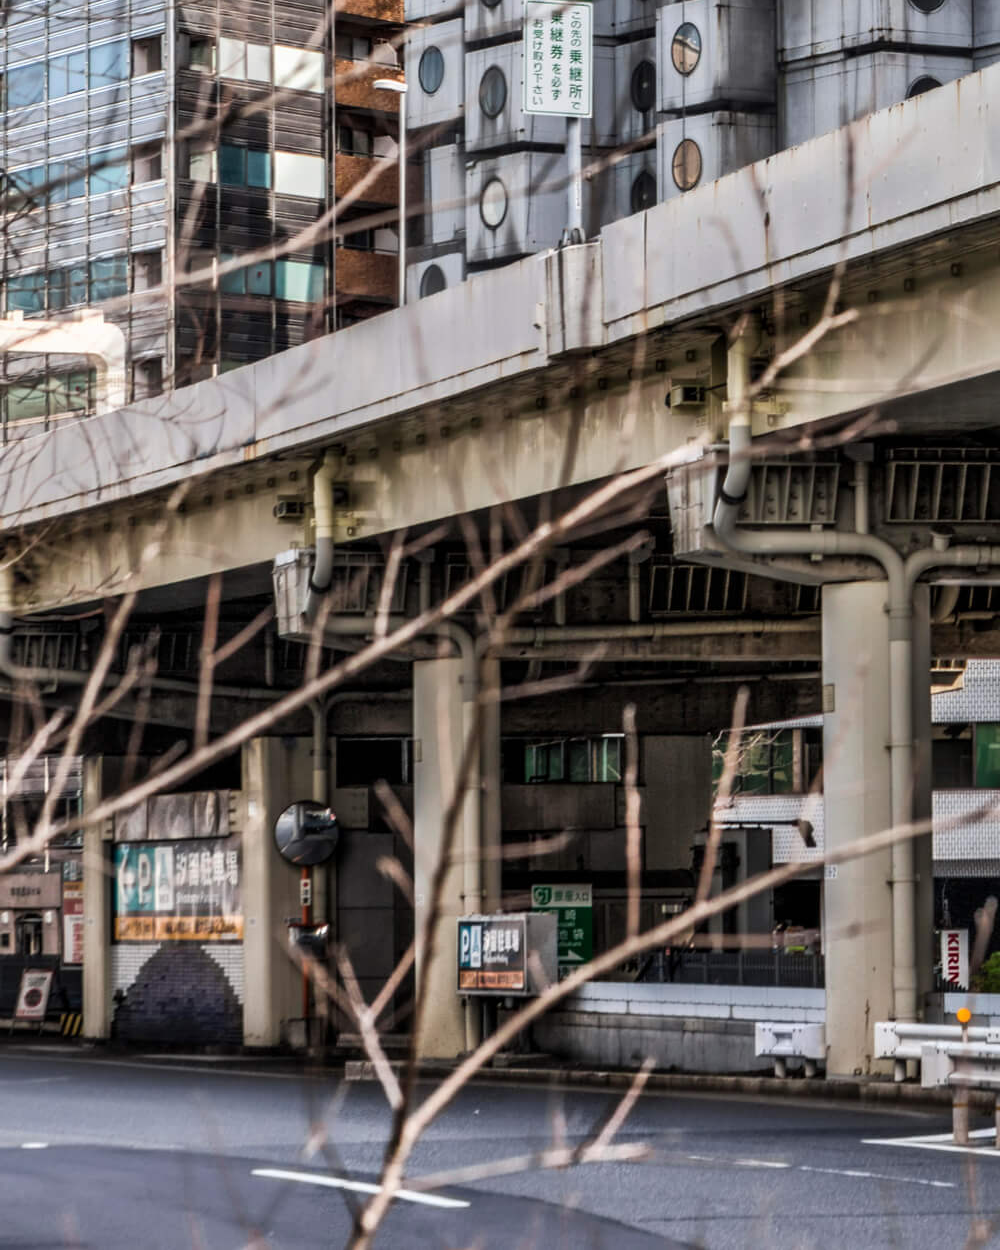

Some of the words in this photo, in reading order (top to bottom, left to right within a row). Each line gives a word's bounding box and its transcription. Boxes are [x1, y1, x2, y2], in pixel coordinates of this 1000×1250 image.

[568, 10, 583, 111] この先の乗継所で
[138, 854, 151, 905] P
[947, 933, 960, 985] KIRIN
